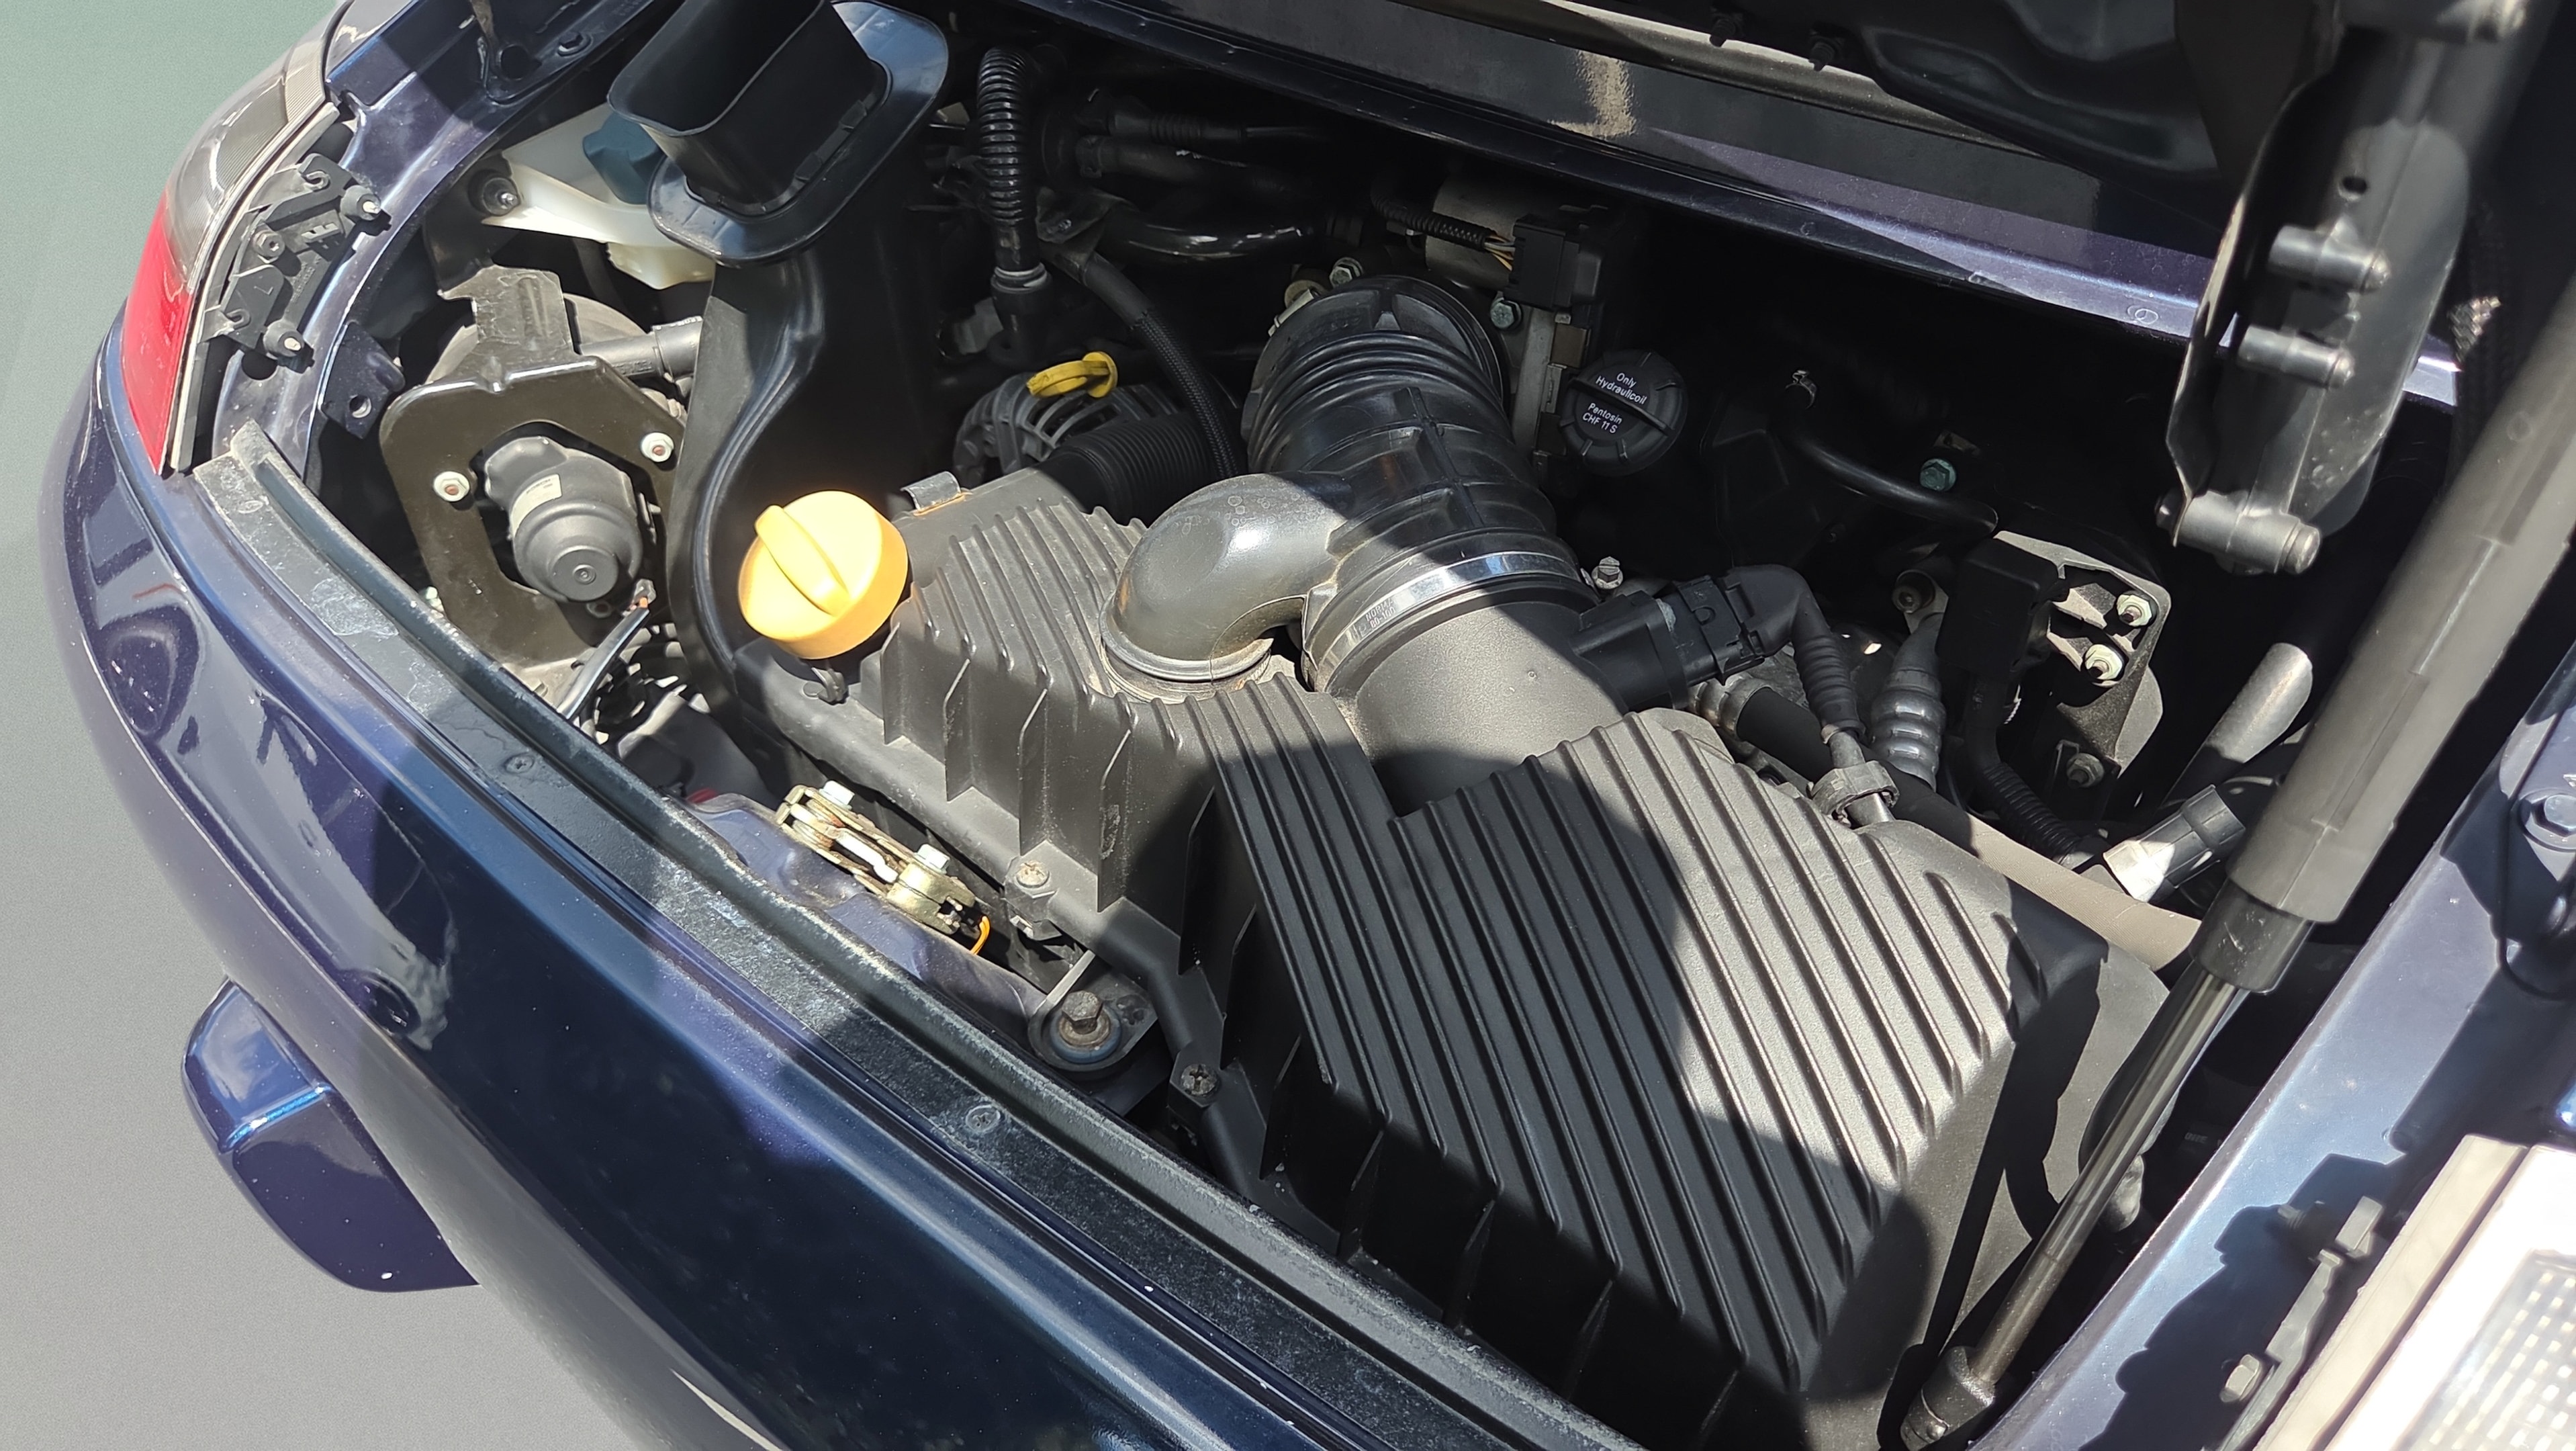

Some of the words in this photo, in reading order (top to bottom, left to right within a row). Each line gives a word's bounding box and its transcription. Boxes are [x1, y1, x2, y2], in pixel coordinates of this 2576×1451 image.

[1596, 376, 1647, 404] Hydraulicoil
[1616, 373, 1637, 388] Only
[1582, 412, 1601, 425] CHF
[1601, 421, 1610, 431] 11
[1610, 425, 1618, 433] S
[1588, 402, 1622, 425] Pentosin
